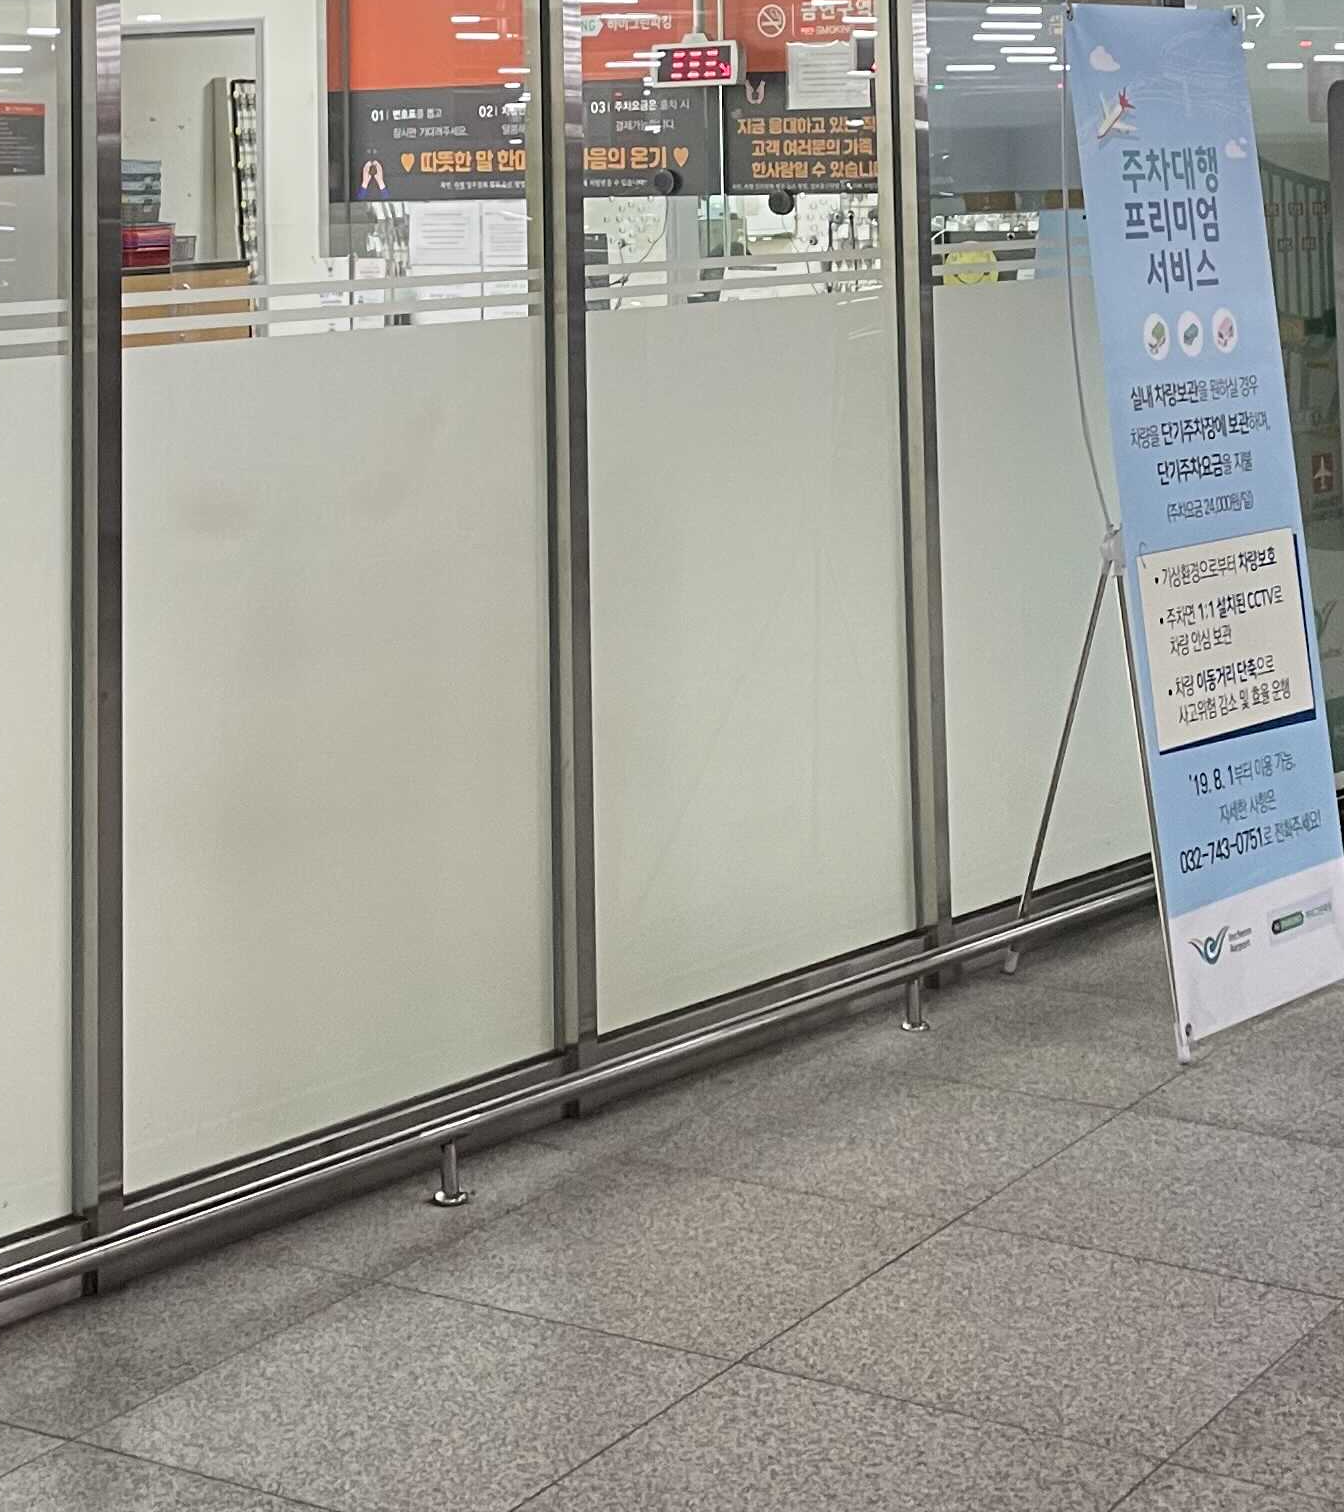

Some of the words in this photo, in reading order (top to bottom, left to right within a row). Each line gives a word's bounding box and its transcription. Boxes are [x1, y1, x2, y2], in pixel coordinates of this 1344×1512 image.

[371, 109, 384, 122] 01
[478, 105, 494, 118] 02
[590, 101, 606, 114] 03
[420, 150, 472, 172] 따뜻한
[475, 150, 493, 172] 말
[631, 146, 667, 169] 온기
[752, 139, 780, 156] 고객
[1122, 145, 1219, 194] 주차대행
[1124, 196, 1219, 242] 프리미엄
[1147, 248, 1219, 293] 서비스
[1130, 384, 1154, 412] 실내
[1155, 379, 1208, 407] 차량보관을
[1240, 374, 1259, 397] 경우
[1130, 424, 1159, 449] 차량을
[1161, 413, 1228, 445] 단기주차장에
[1157, 452, 1232, 486] 단기주차요금을
[1162, 553, 1237, 588] 기상환경으로부터
[1238, 546, 1277, 573] 차량보호
[1166, 603, 1196, 629] 주차면
[1216, 591, 1246, 619] 설치된
[1247, 584, 1284, 610] CCTV로
[1169, 634, 1189, 657] 차량
[1191, 628, 1212, 652] 안심
[1213, 624, 1233, 646] 보관
[1175, 672, 1195, 698] 차량
[1196, 662, 1236, 693] 이동거리
[1236, 654, 1275, 683] 단축으로
[1178, 697, 1218, 724] 사고위험
[1218, 693, 1239, 717] 감소
[1272, 676, 1291, 701] 운행
[1218, 799, 1248, 824] 자세한
